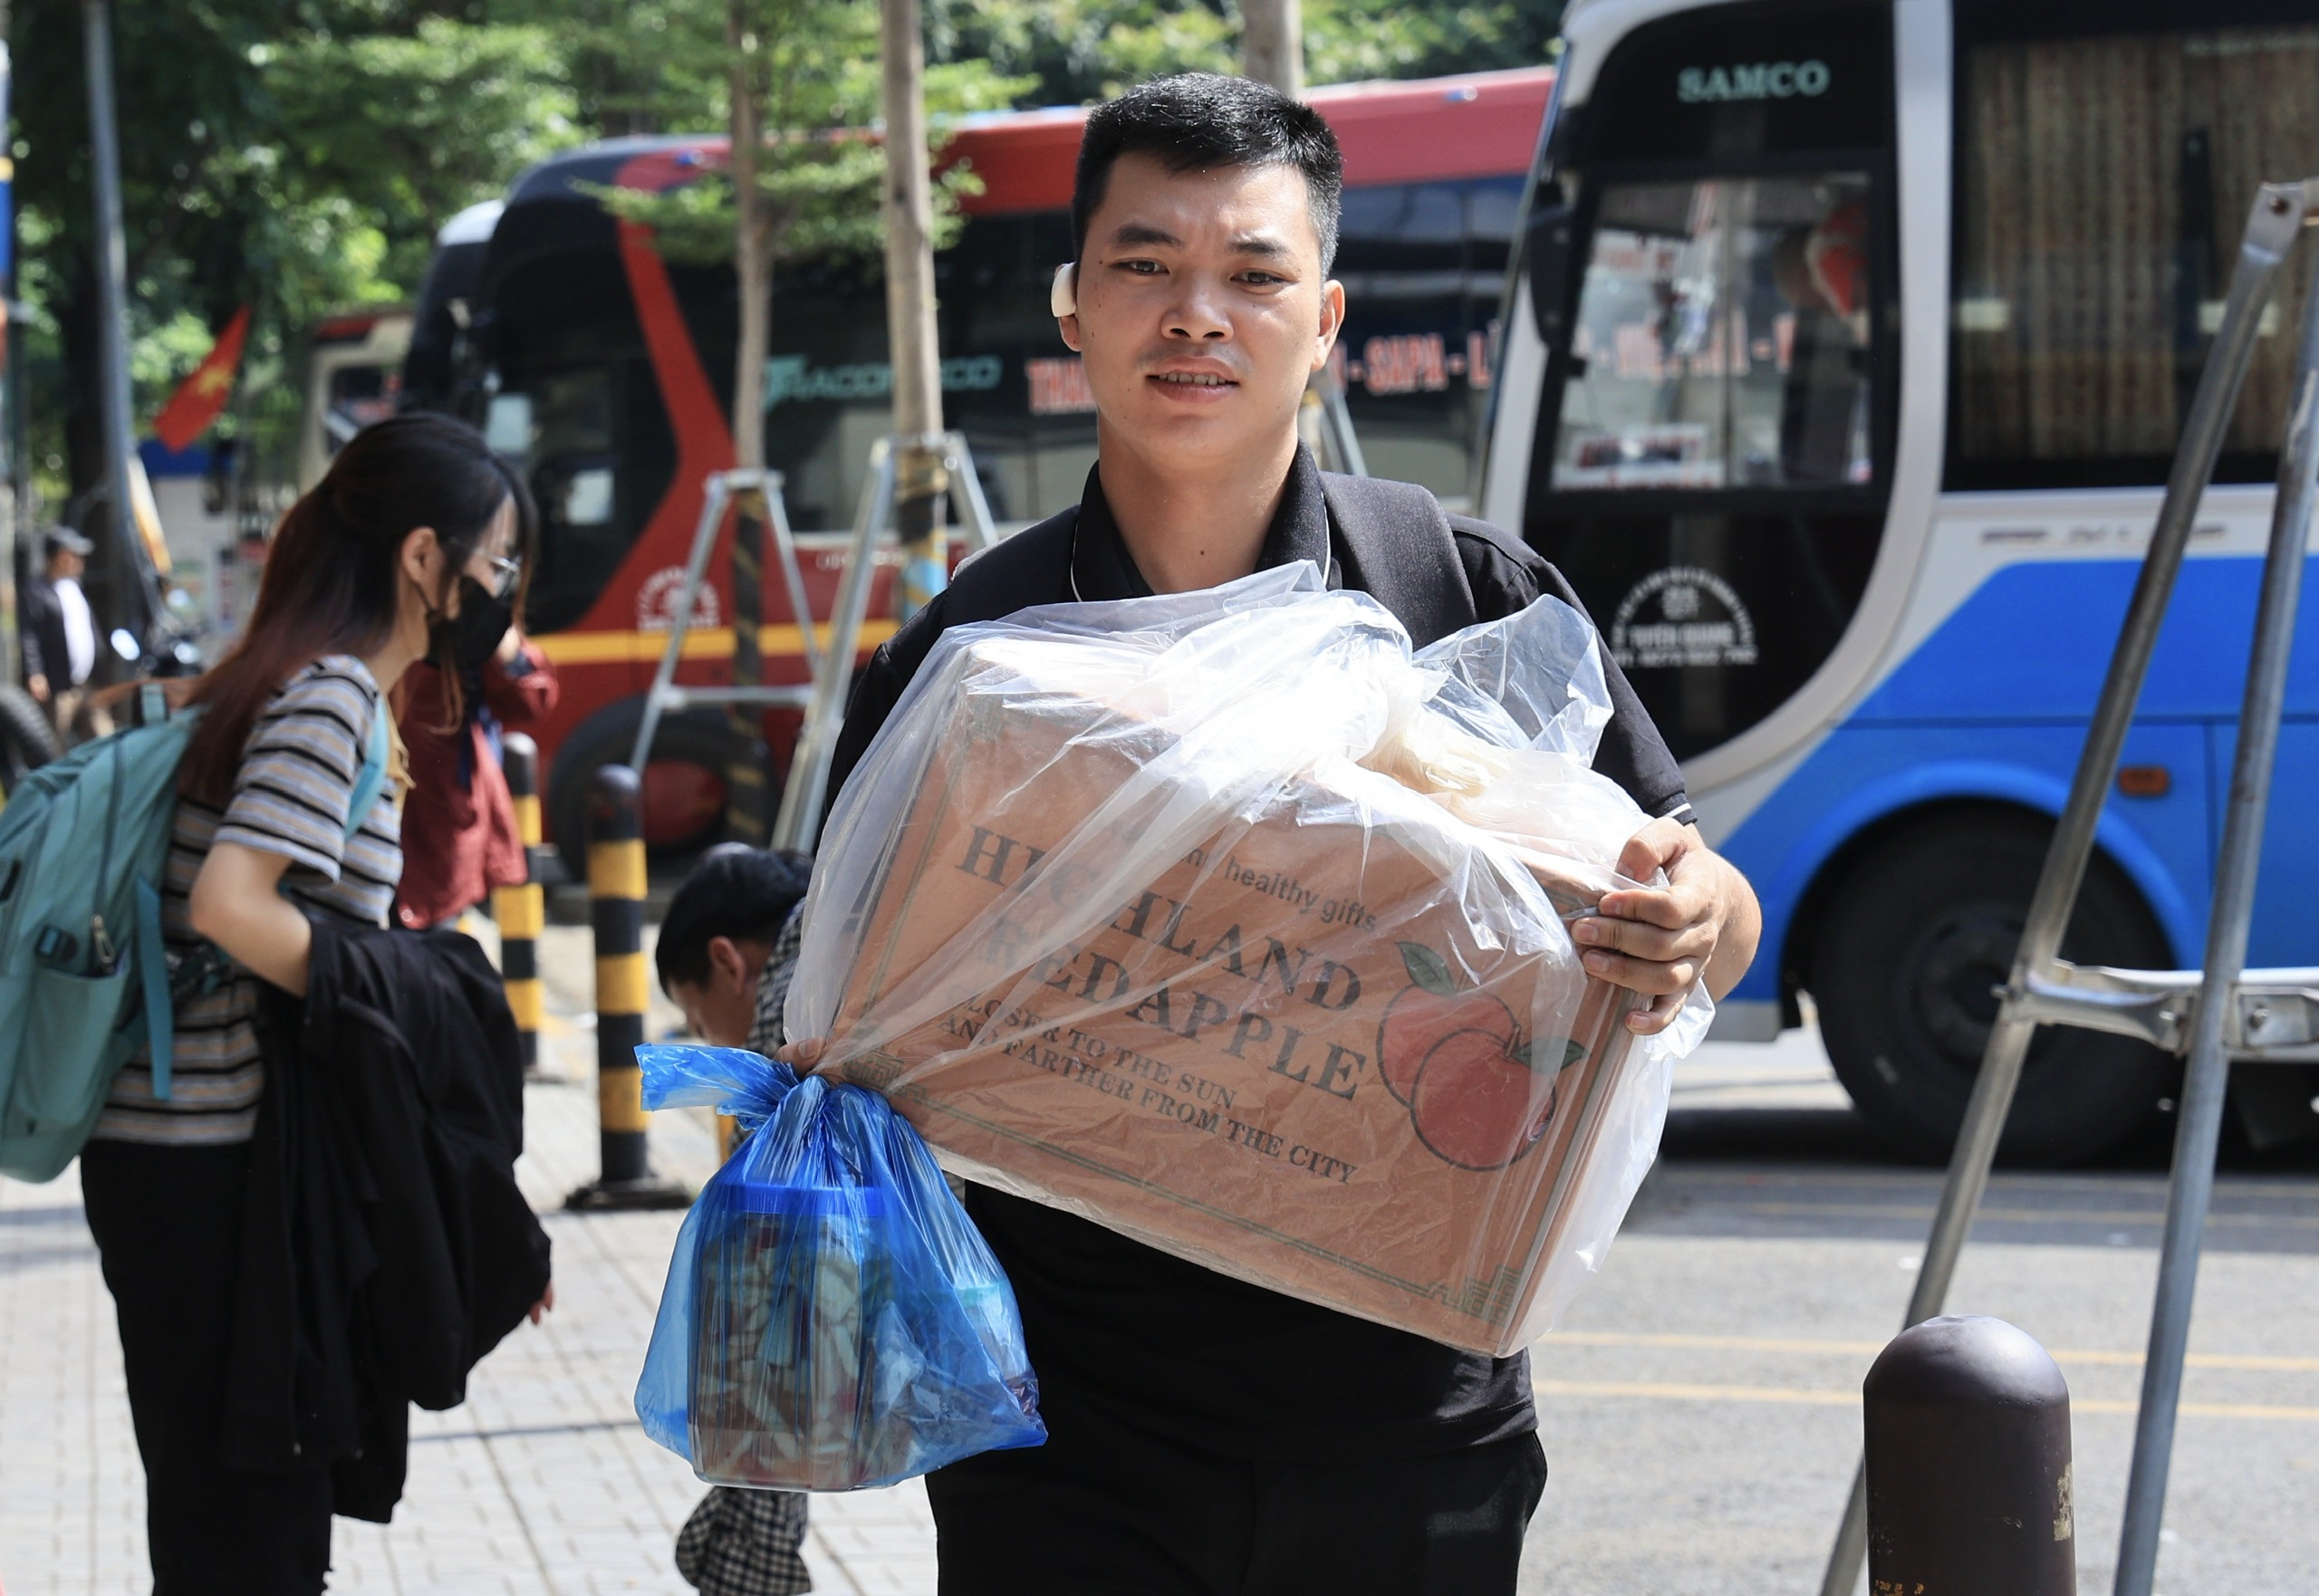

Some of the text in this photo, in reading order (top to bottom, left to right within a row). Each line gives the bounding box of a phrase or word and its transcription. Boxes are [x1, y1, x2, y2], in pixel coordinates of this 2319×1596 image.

[1678, 61, 1830, 102] SAMCO
[1224, 856, 1319, 914] healthy
[1321, 897, 1378, 932] gifts
[949, 987, 1237, 1110] LOSER TO THE SUN
[1125, 977, 1367, 1101] APPLE
[1001, 1038, 1135, 1101] FARTHER
[1140, 1087, 1223, 1134] FROM
[1227, 1119, 1285, 1158] THE
[1288, 1144, 1358, 1186] CITY
